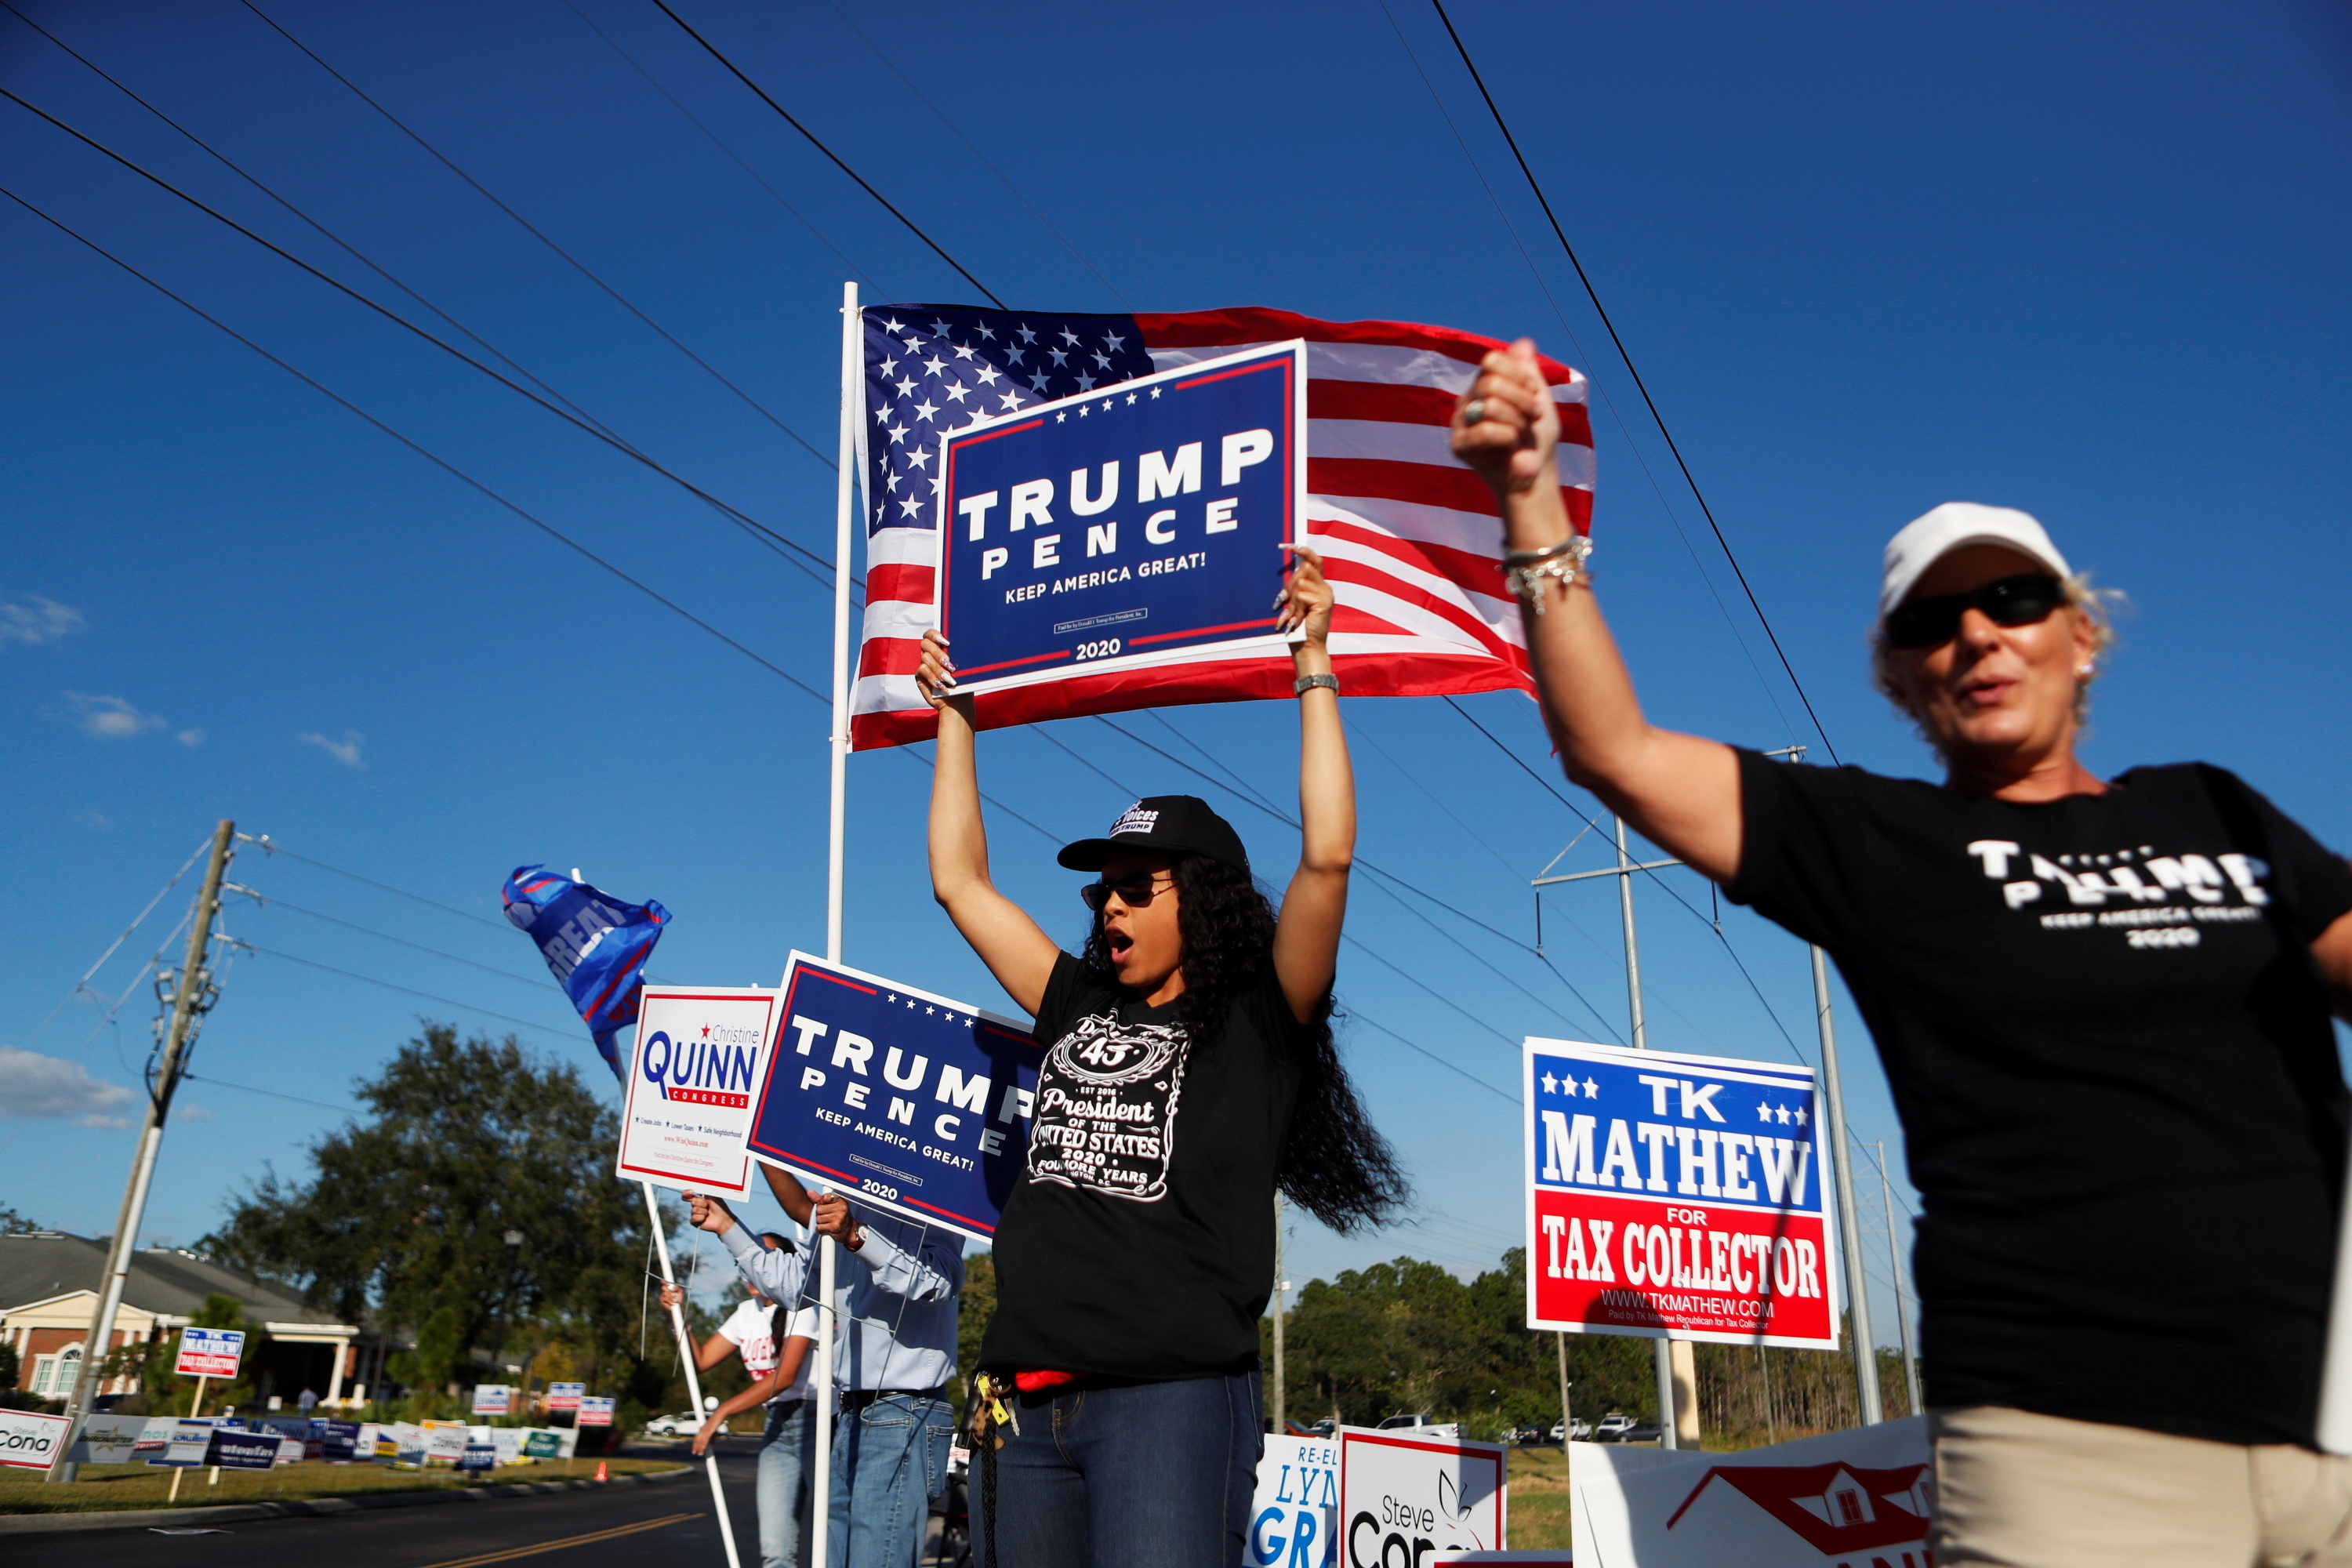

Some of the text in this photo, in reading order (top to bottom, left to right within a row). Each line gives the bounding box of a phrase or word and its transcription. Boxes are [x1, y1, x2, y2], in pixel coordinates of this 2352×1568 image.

[958, 428, 1274, 542] TRUMP
[982, 496, 1238, 580] PENCE
[1006, 552, 1207, 604] KEEP AMERICA GREAT!
[1076, 638, 1121, 660] 2020
[2125, 927, 2201, 949] 2020
[713, 1025, 759, 1044] Christine
[643, 1030, 757, 1100] QUINN
[1080, 1036, 1134, 1066] 45
[791, 1014, 1036, 1124] TRUMP
[673, 1091, 745, 1105] CONGRESS
[1040, 1087, 1155, 1123] President
[1080, 1086, 1116, 1096] EST 2016
[1639, 1074, 1727, 1123] TK
[800, 1066, 1007, 1156] PENCE
[1069, 1117, 1116, 1132] OF THE
[815, 1107, 975, 1172] KEEP AMERICA GREAT!
[1089, 1132, 1160, 1160] STATES
[1062, 1148, 1105, 1167] 2020
[1541, 1109, 1812, 1206] MATHEW
[1037, 1160, 1063, 1171] FOU
[1103, 1167, 1148, 1185] YEARS
[862, 1178, 898, 1200] 2020
[1666, 1207, 1708, 1226] FOR
[1542, 1214, 1821, 1298] TAX COLLECTOR
[1601, 1288, 1775, 1318] WWW.TKMATHEW.COM
[1608, 1309, 1769, 1329] Paid by TK Mathew Republican for Tax Collector
[184, 1338, 241, 1354] MATHEW
[13, 1426, 38, 1436] Steve
[1382, 1494, 1434, 1533] Steve
